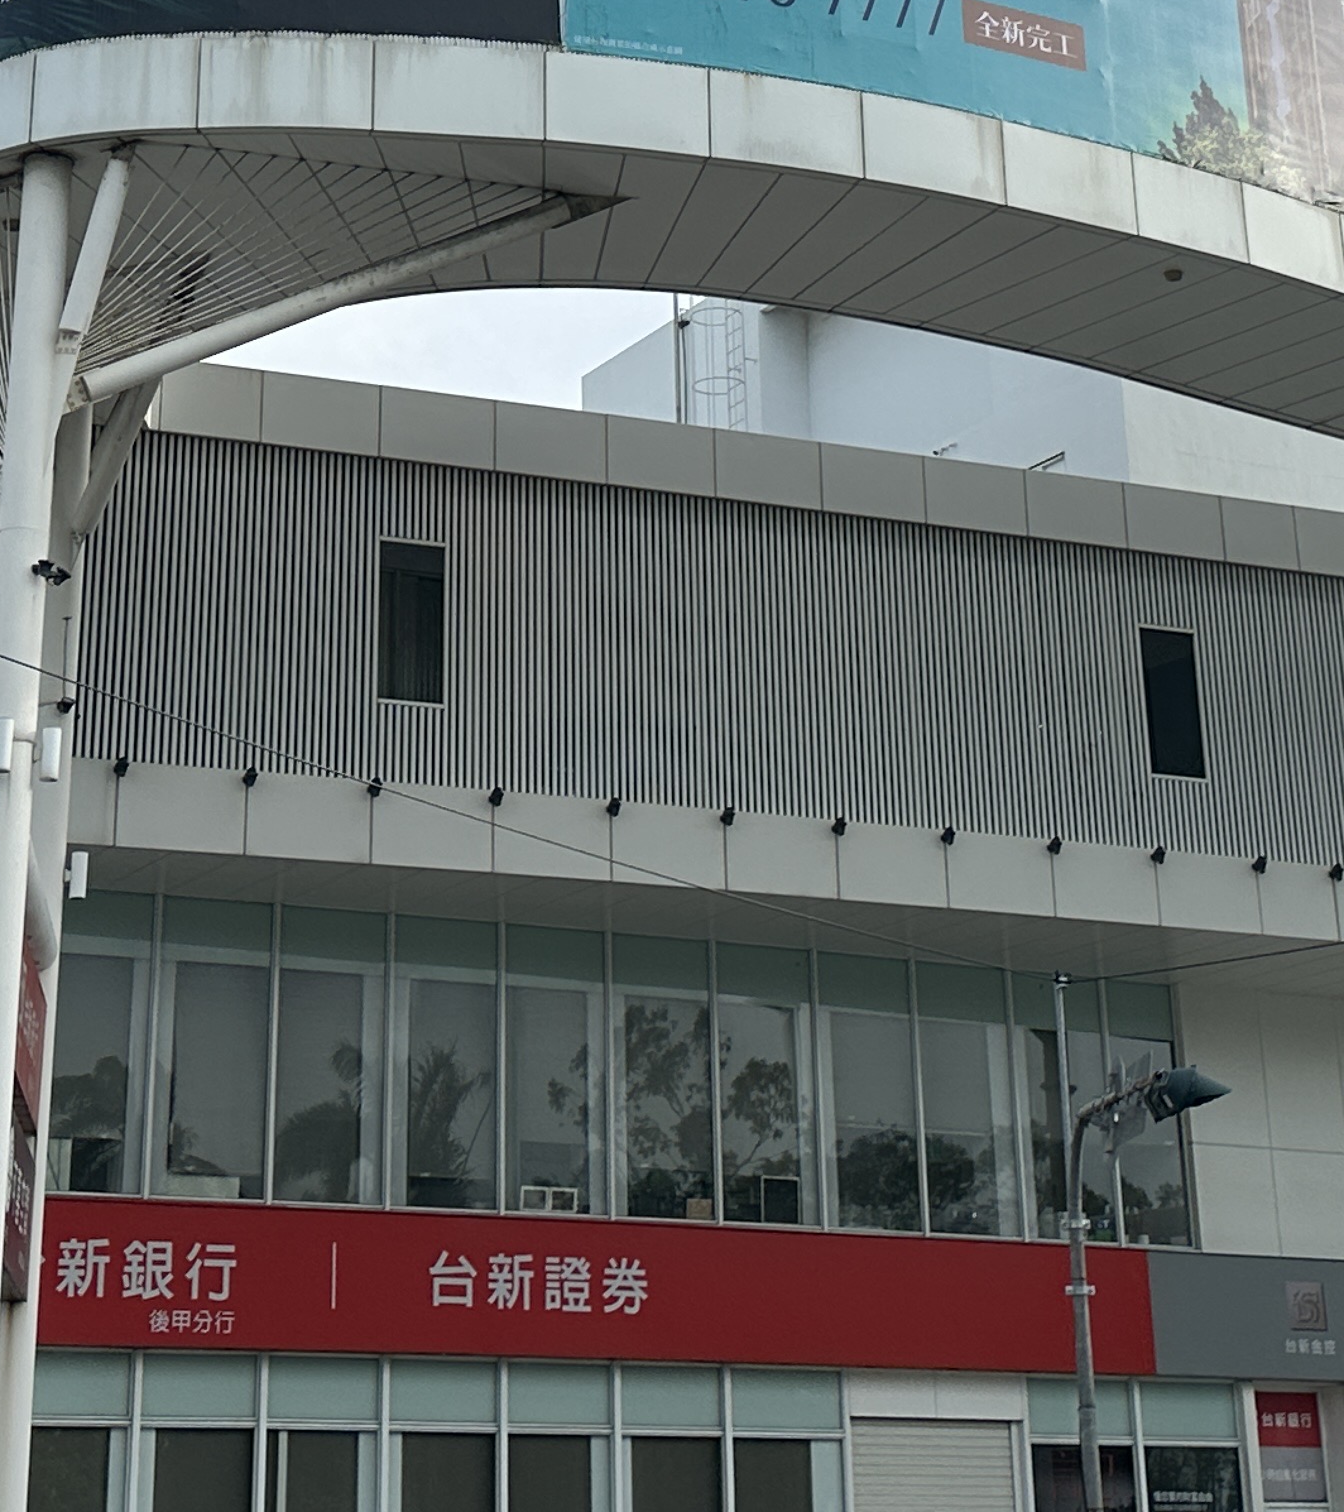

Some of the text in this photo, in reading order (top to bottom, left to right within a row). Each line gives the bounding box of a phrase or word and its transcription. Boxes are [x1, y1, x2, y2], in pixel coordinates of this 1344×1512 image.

[974, 9, 1079, 59] 全新完工
[41, 1236, 238, 1303] 新銀行
[428, 1248, 649, 1316] 台新證券
[149, 1309, 235, 1335] 後甲分行
